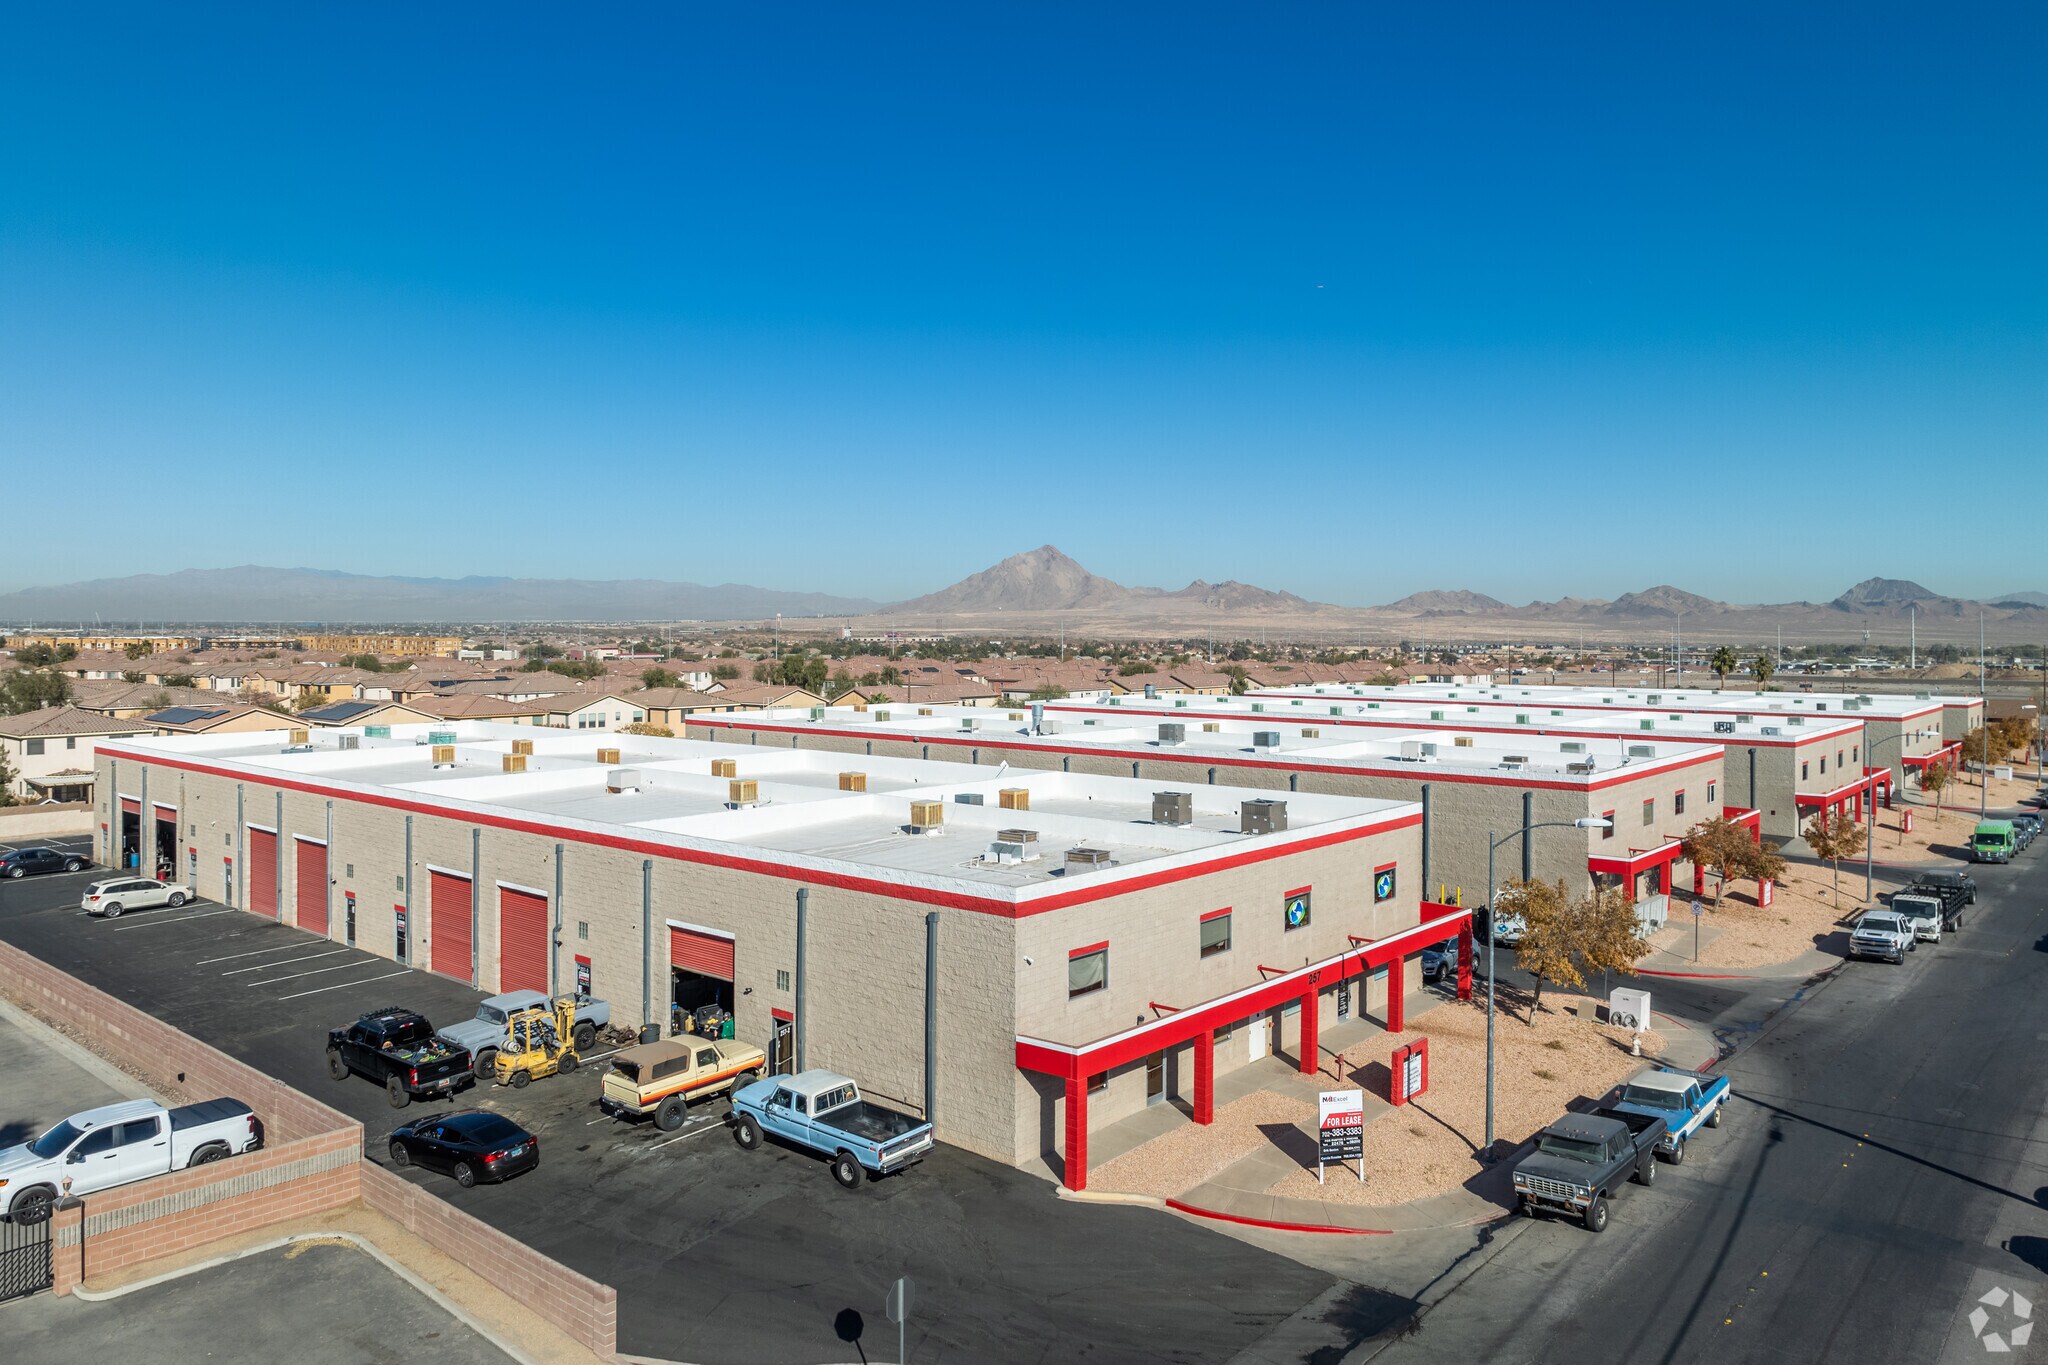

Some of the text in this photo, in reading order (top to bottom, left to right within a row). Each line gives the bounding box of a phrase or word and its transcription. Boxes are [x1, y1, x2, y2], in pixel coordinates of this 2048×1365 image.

[1308, 971, 1321, 985] 257
[1327, 1116, 1362, 1127] FOR LEASE
[1321, 1127, 1362, 1138] 702-383-3383
